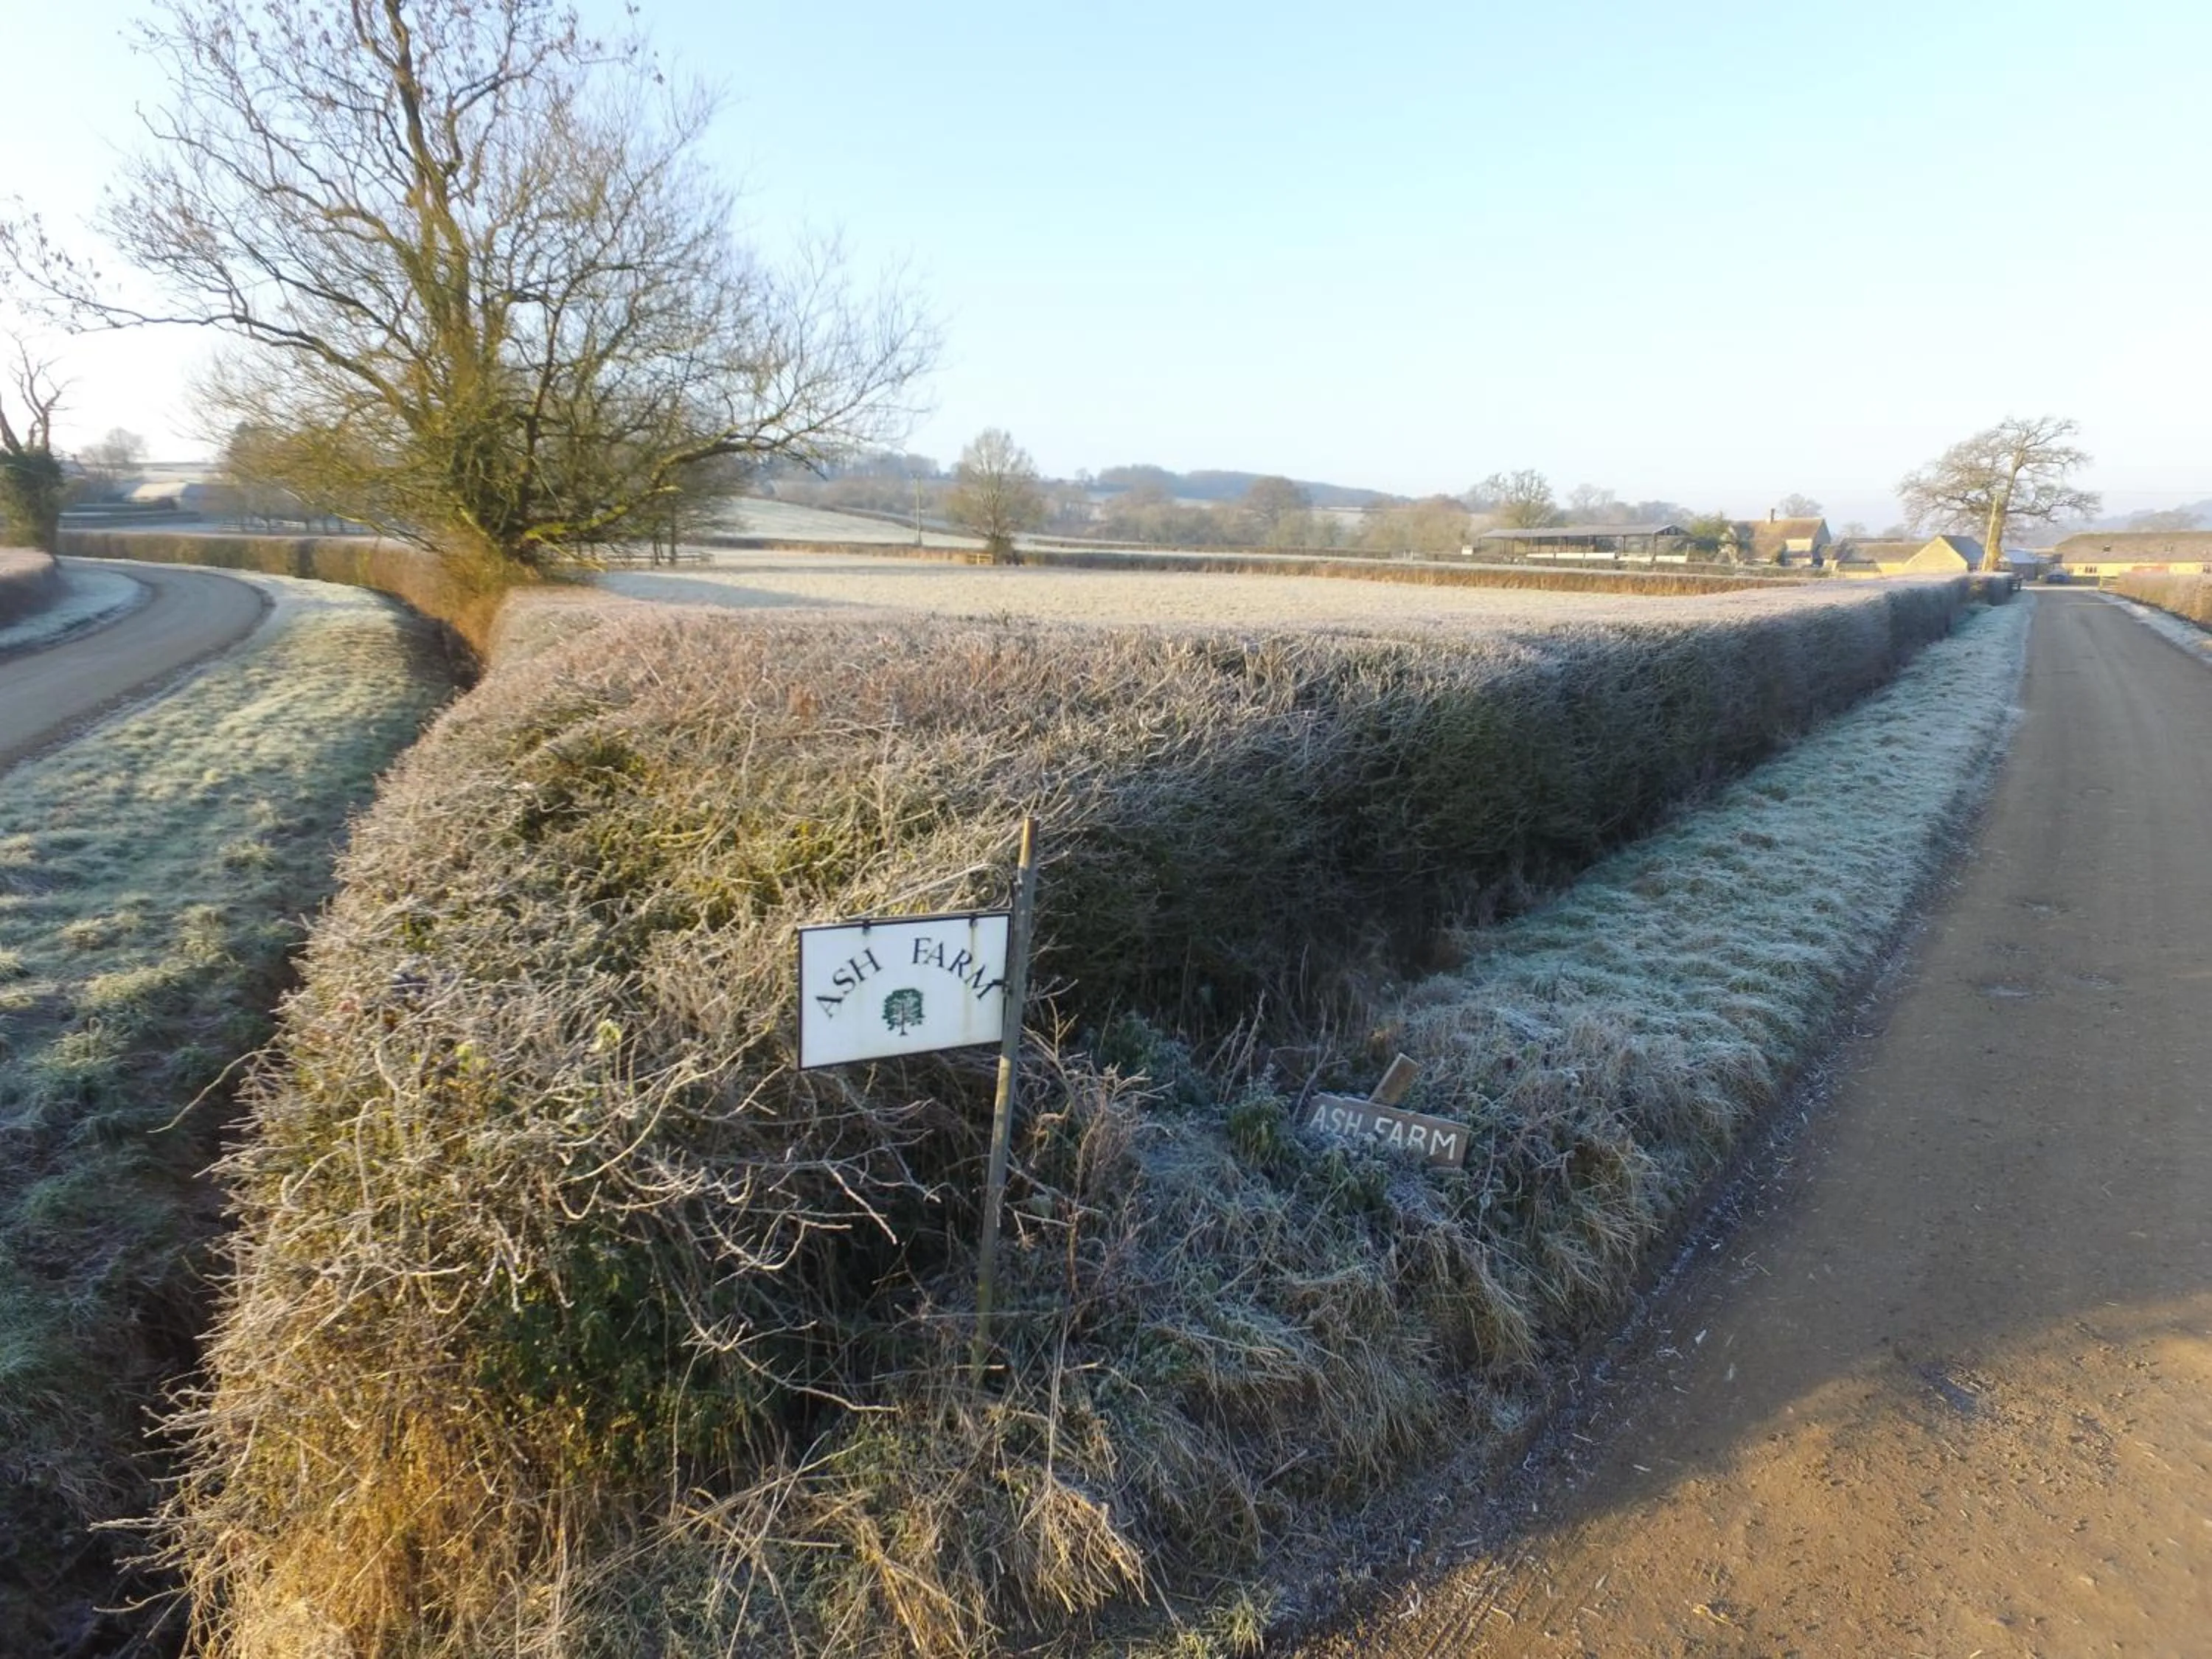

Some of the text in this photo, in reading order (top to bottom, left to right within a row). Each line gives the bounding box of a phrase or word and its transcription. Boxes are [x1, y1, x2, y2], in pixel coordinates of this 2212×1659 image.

[815, 937, 998, 1019] ASH FARM
[1310, 1105, 1363, 1137] ASH
